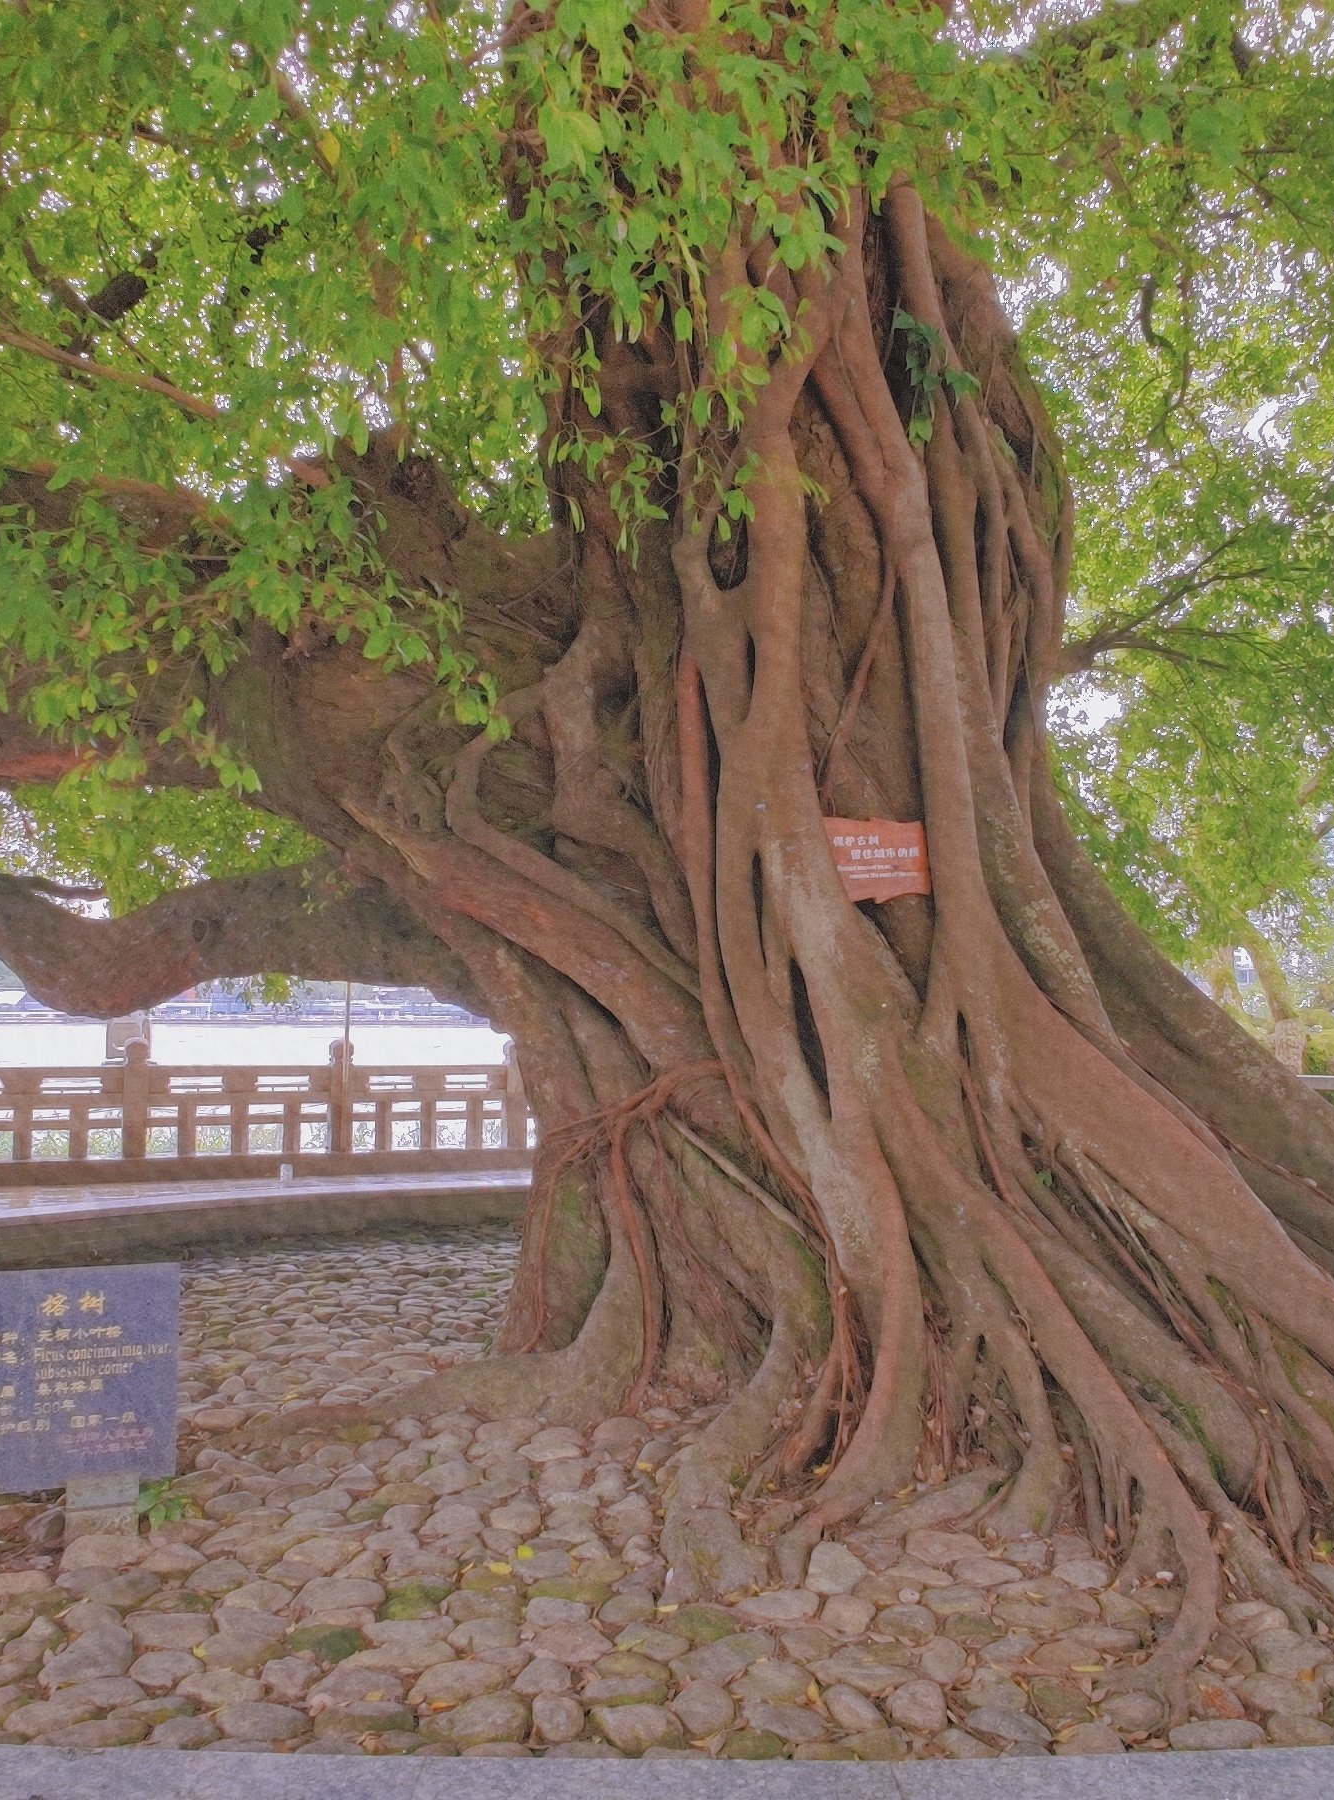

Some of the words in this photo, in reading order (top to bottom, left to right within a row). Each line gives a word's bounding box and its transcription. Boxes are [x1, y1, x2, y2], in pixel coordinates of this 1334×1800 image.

[833, 835, 879, 847] 保护古树
[39, 1290, 106, 1317] 榕树
